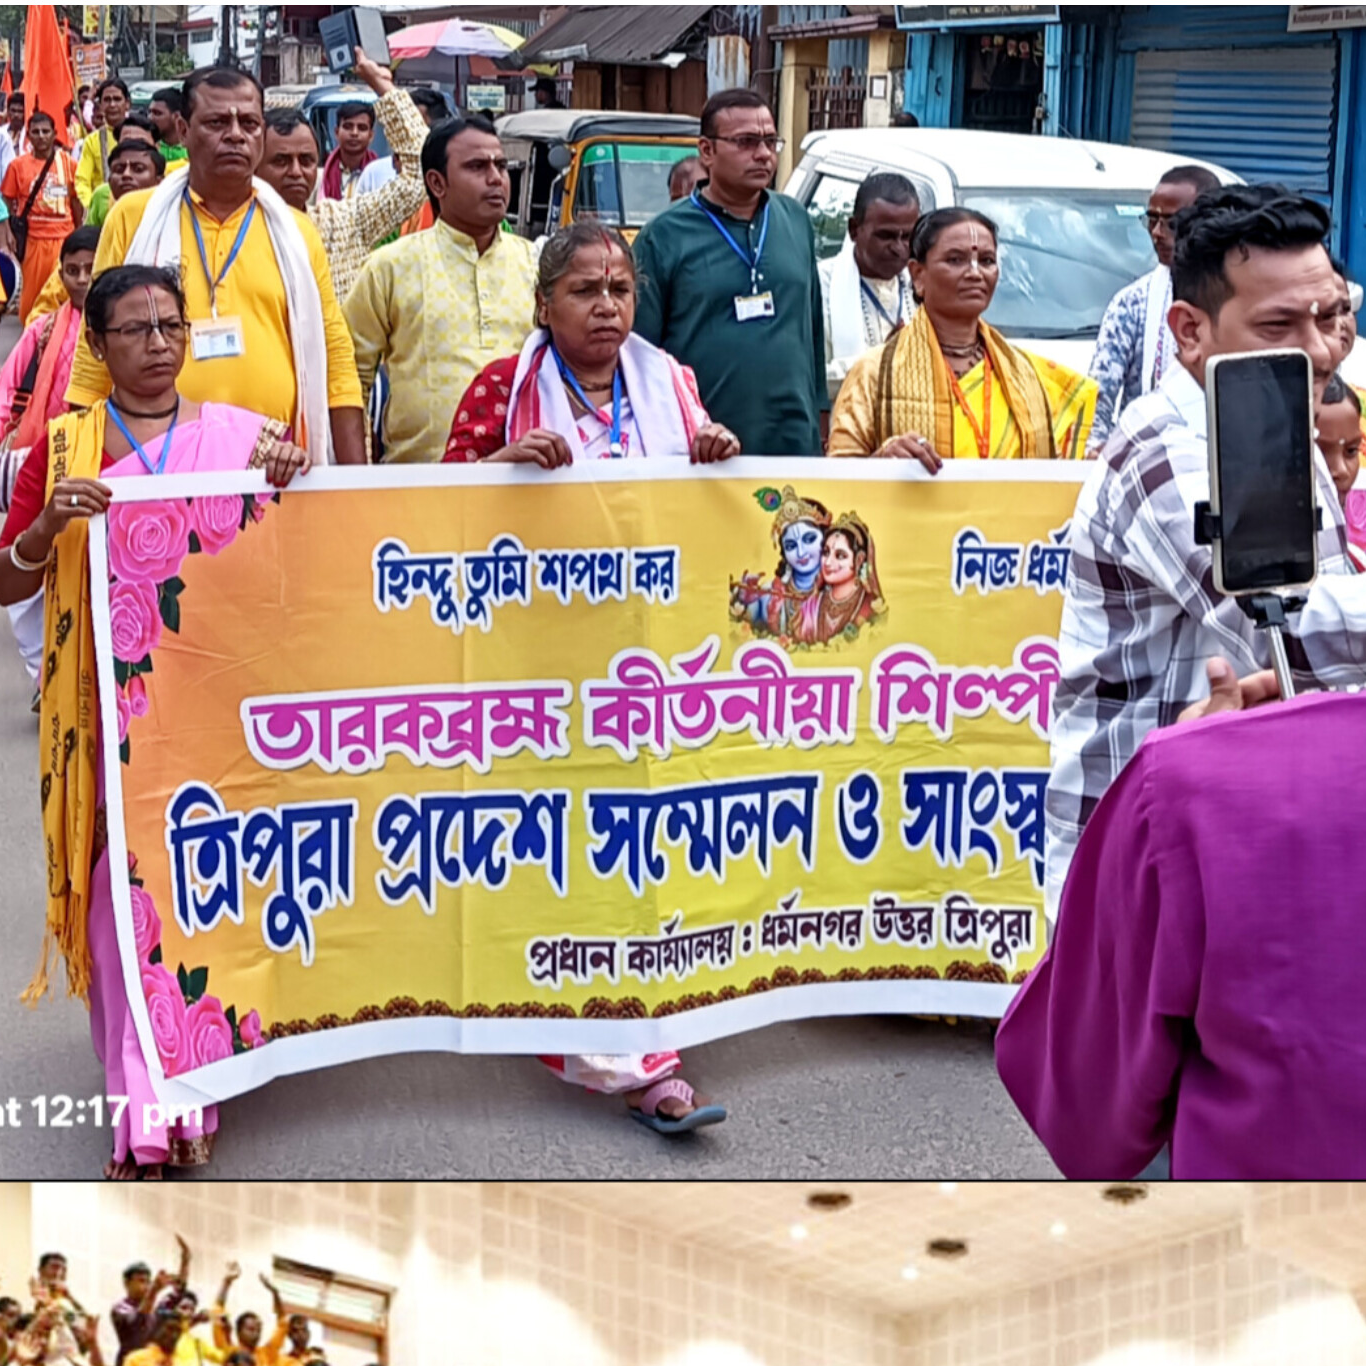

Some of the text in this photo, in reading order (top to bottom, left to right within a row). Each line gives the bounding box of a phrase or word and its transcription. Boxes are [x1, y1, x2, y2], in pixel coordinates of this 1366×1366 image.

[377, 537, 676, 626] হিন্দু তুমি শপথ কর
[955, 523, 1071, 589] নিজ ধর্ম
[249, 688, 565, 766] তারকব্রহ্ম
[170, 786, 354, 960] ত্রিপুরা
[377, 793, 567, 910] প্রদেশ
[588, 775, 819, 892] সম্মেলন
[838, 773, 879, 860] ও
[530, 938, 617, 984] প্রধান
[762, 893, 863, 948] ধর্মনগর
[873, 898, 934, 945] উত্তর
[944, 895, 1033, 963] ত্রিপুরা
